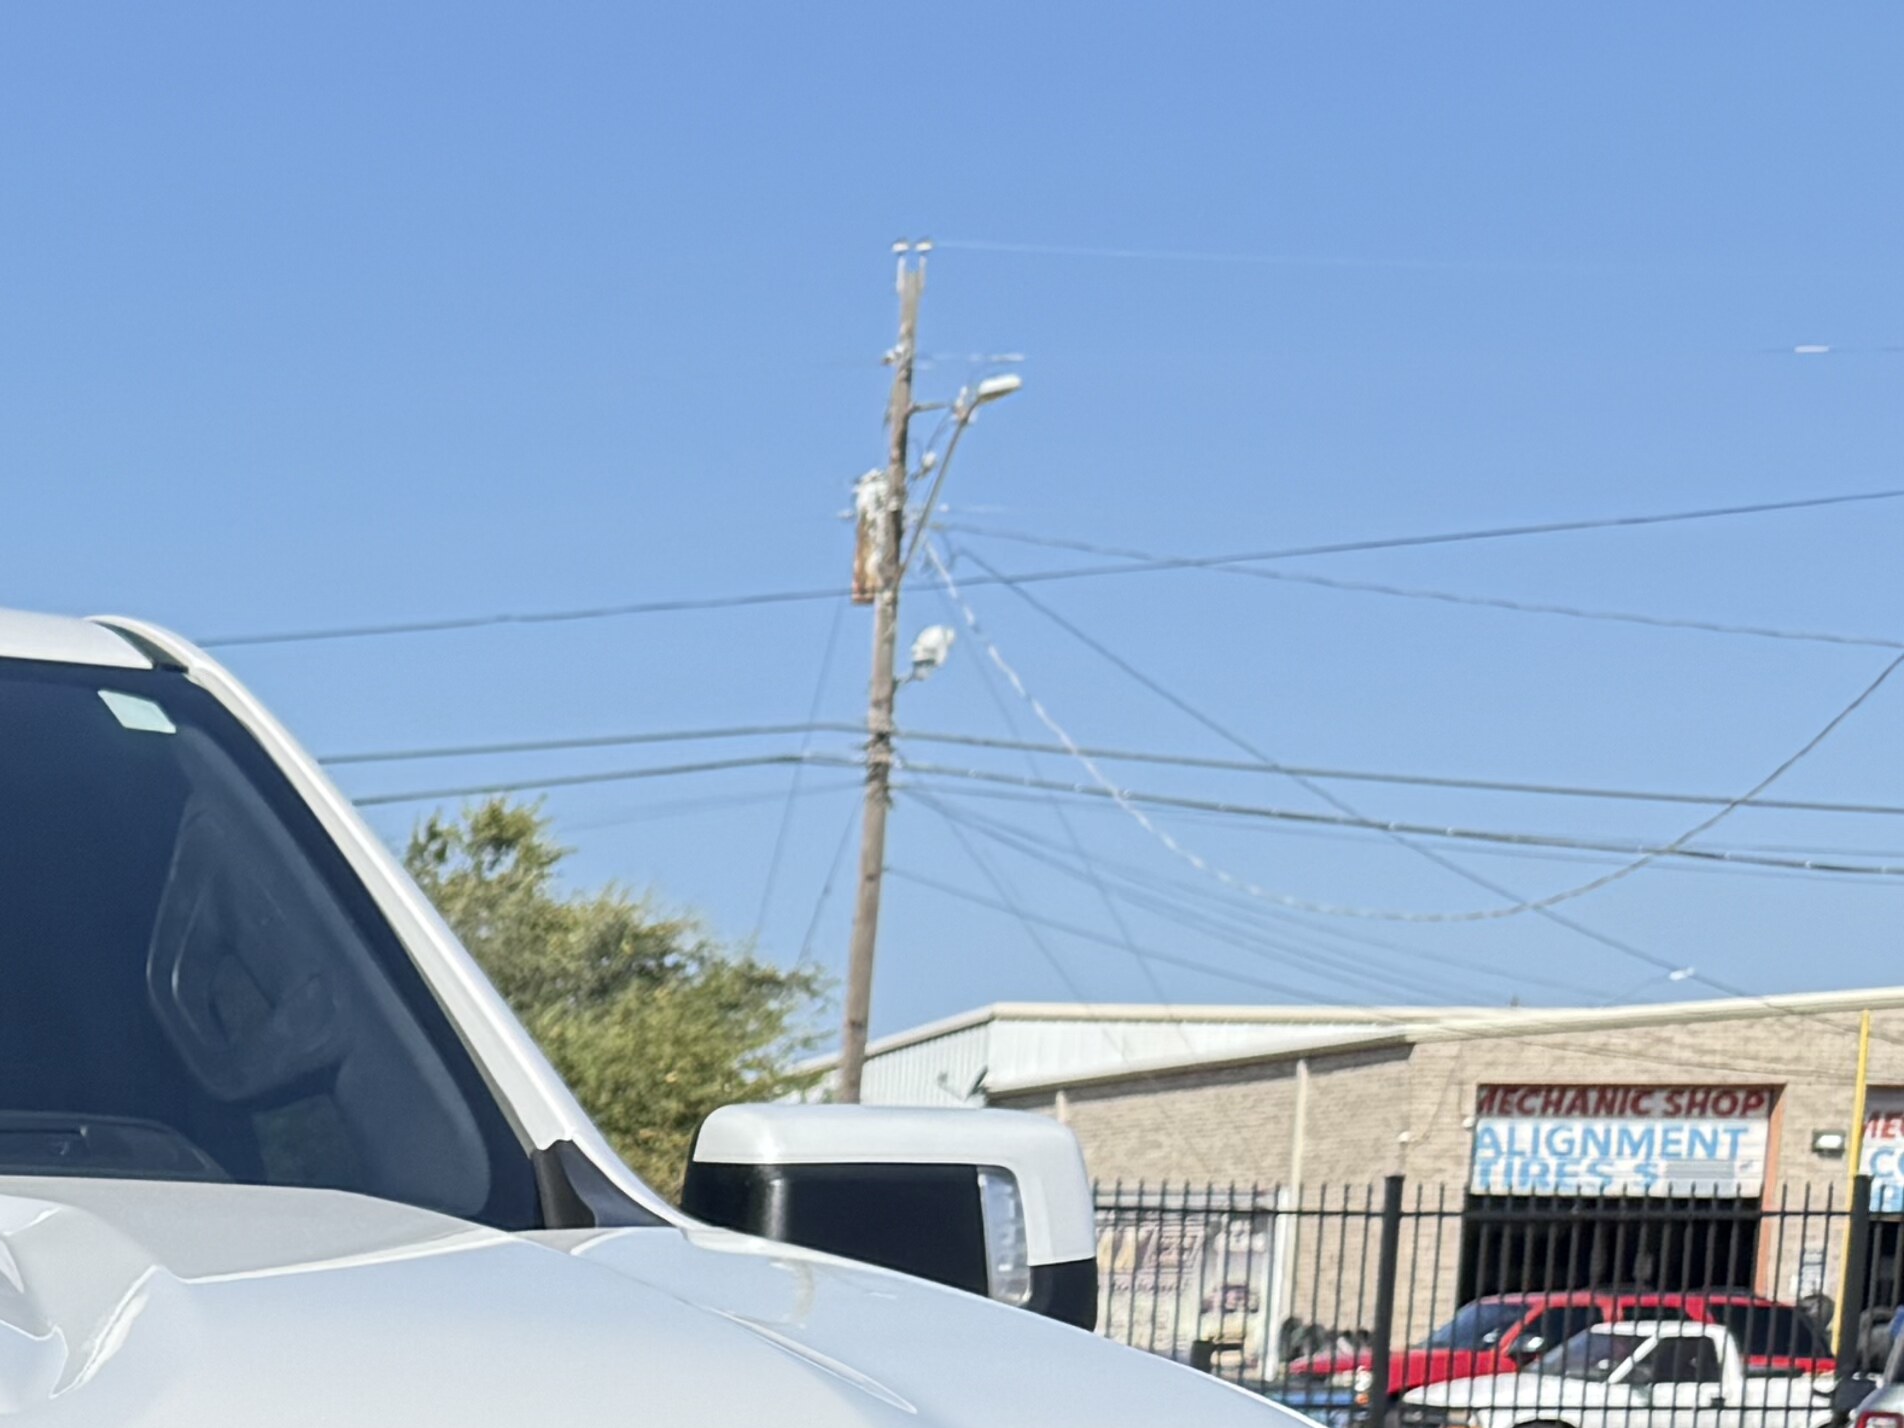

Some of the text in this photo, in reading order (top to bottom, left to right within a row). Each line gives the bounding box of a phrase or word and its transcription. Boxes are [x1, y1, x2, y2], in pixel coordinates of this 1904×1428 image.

[1662, 1087, 1766, 1118] SHOP
[1475, 1125, 1750, 1161] ALIGNMENT
[1477, 1159, 1614, 1188] TIRES
